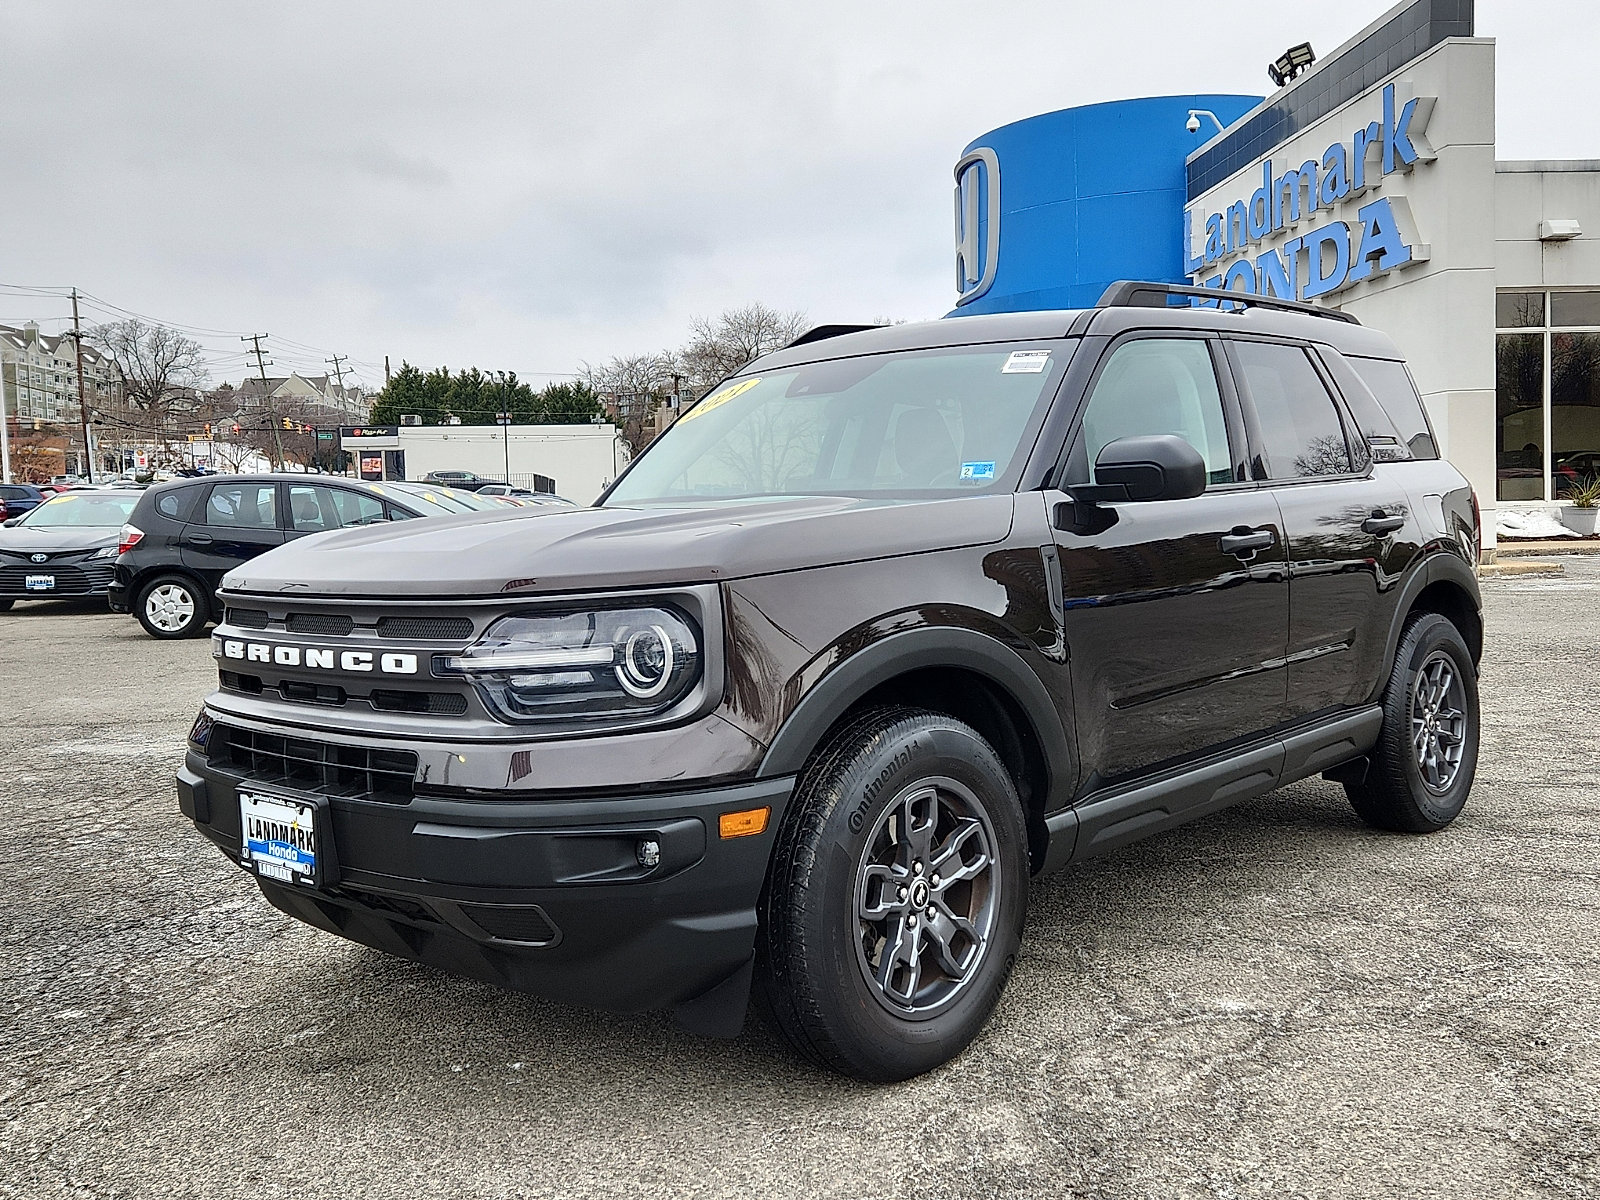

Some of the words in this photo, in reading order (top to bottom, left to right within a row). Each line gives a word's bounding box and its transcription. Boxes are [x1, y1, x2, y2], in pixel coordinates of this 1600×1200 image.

[1184, 82, 1420, 278] Landmark
[1188, 196, 1412, 309] HONDA
[224, 640, 418, 674] BRONCO
[847, 744, 913, 835] Continental
[248, 816, 316, 853] LANDMARK
[268, 842, 299, 861] Honda
